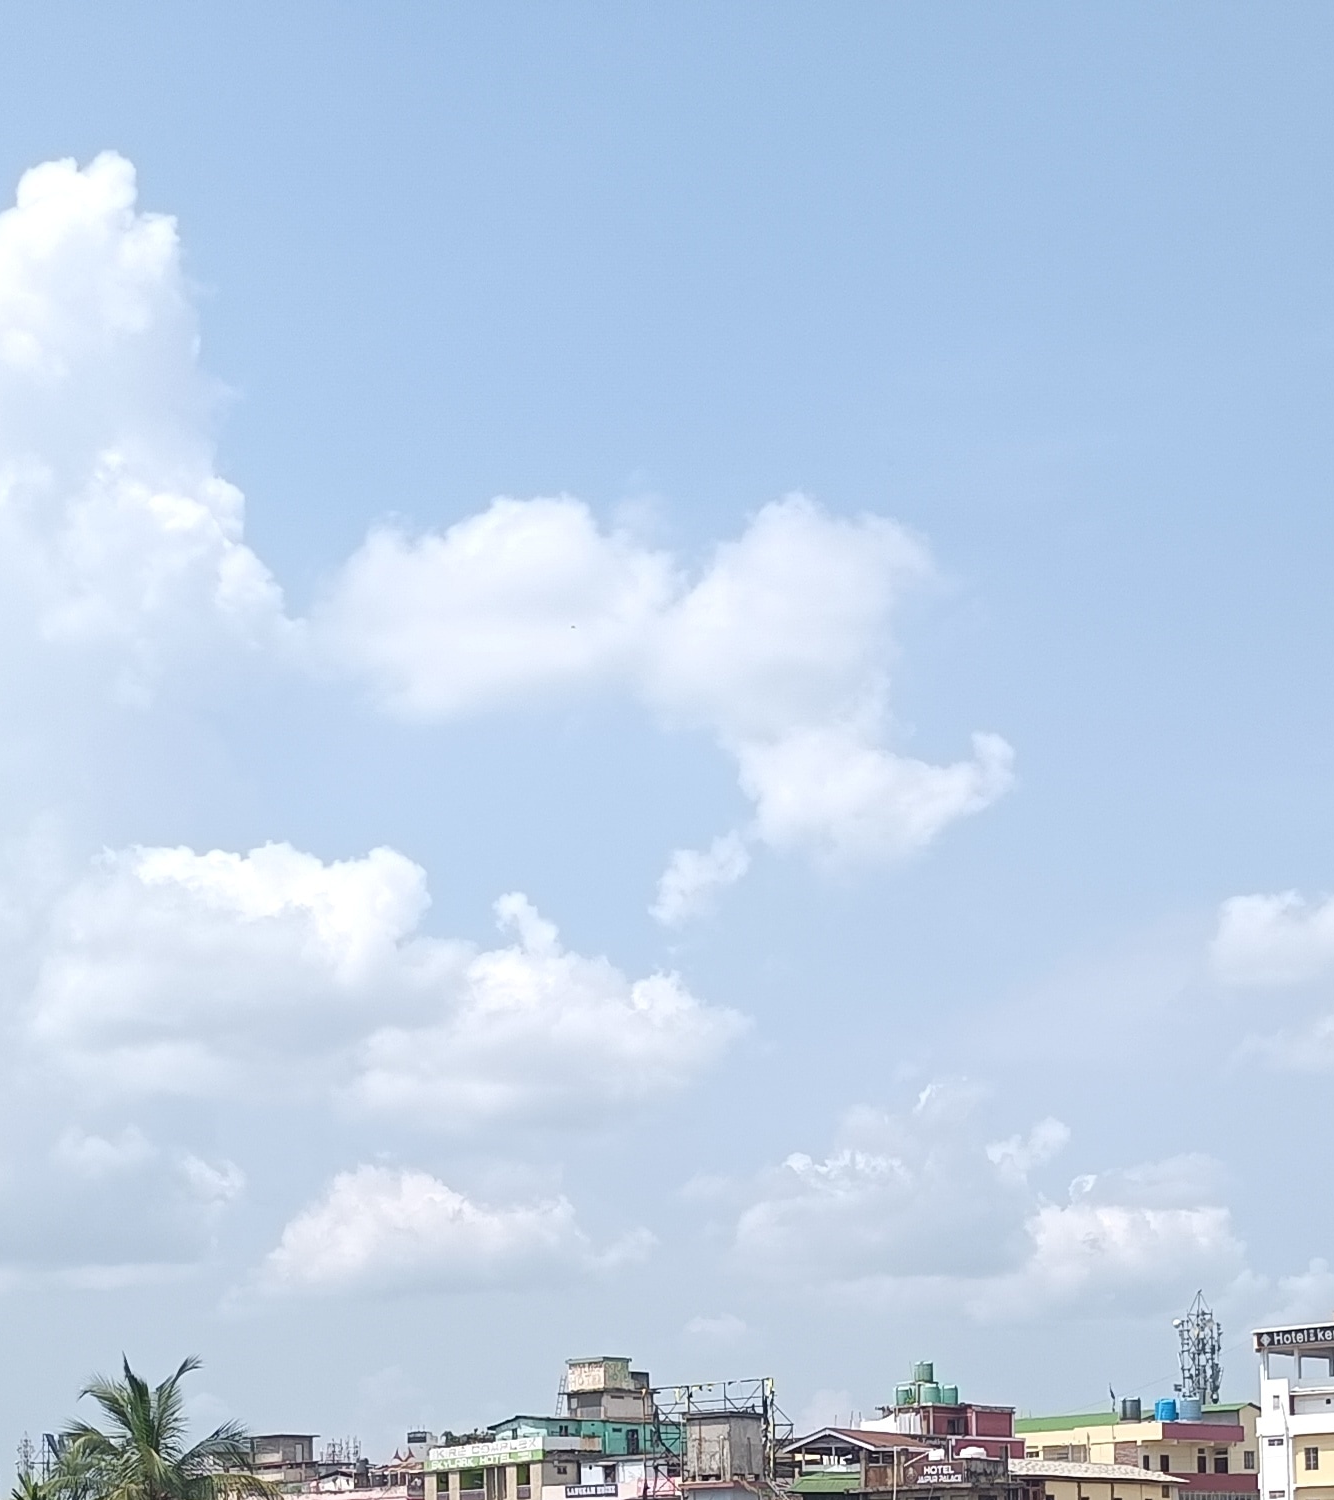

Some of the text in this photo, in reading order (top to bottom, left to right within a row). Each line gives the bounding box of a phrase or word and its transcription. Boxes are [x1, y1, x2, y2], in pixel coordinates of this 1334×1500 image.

[1273, 1328, 1308, 1345] Hotel
[479, 1453, 513, 1466] HOTEL
[923, 1465, 955, 1475] HOTEL
